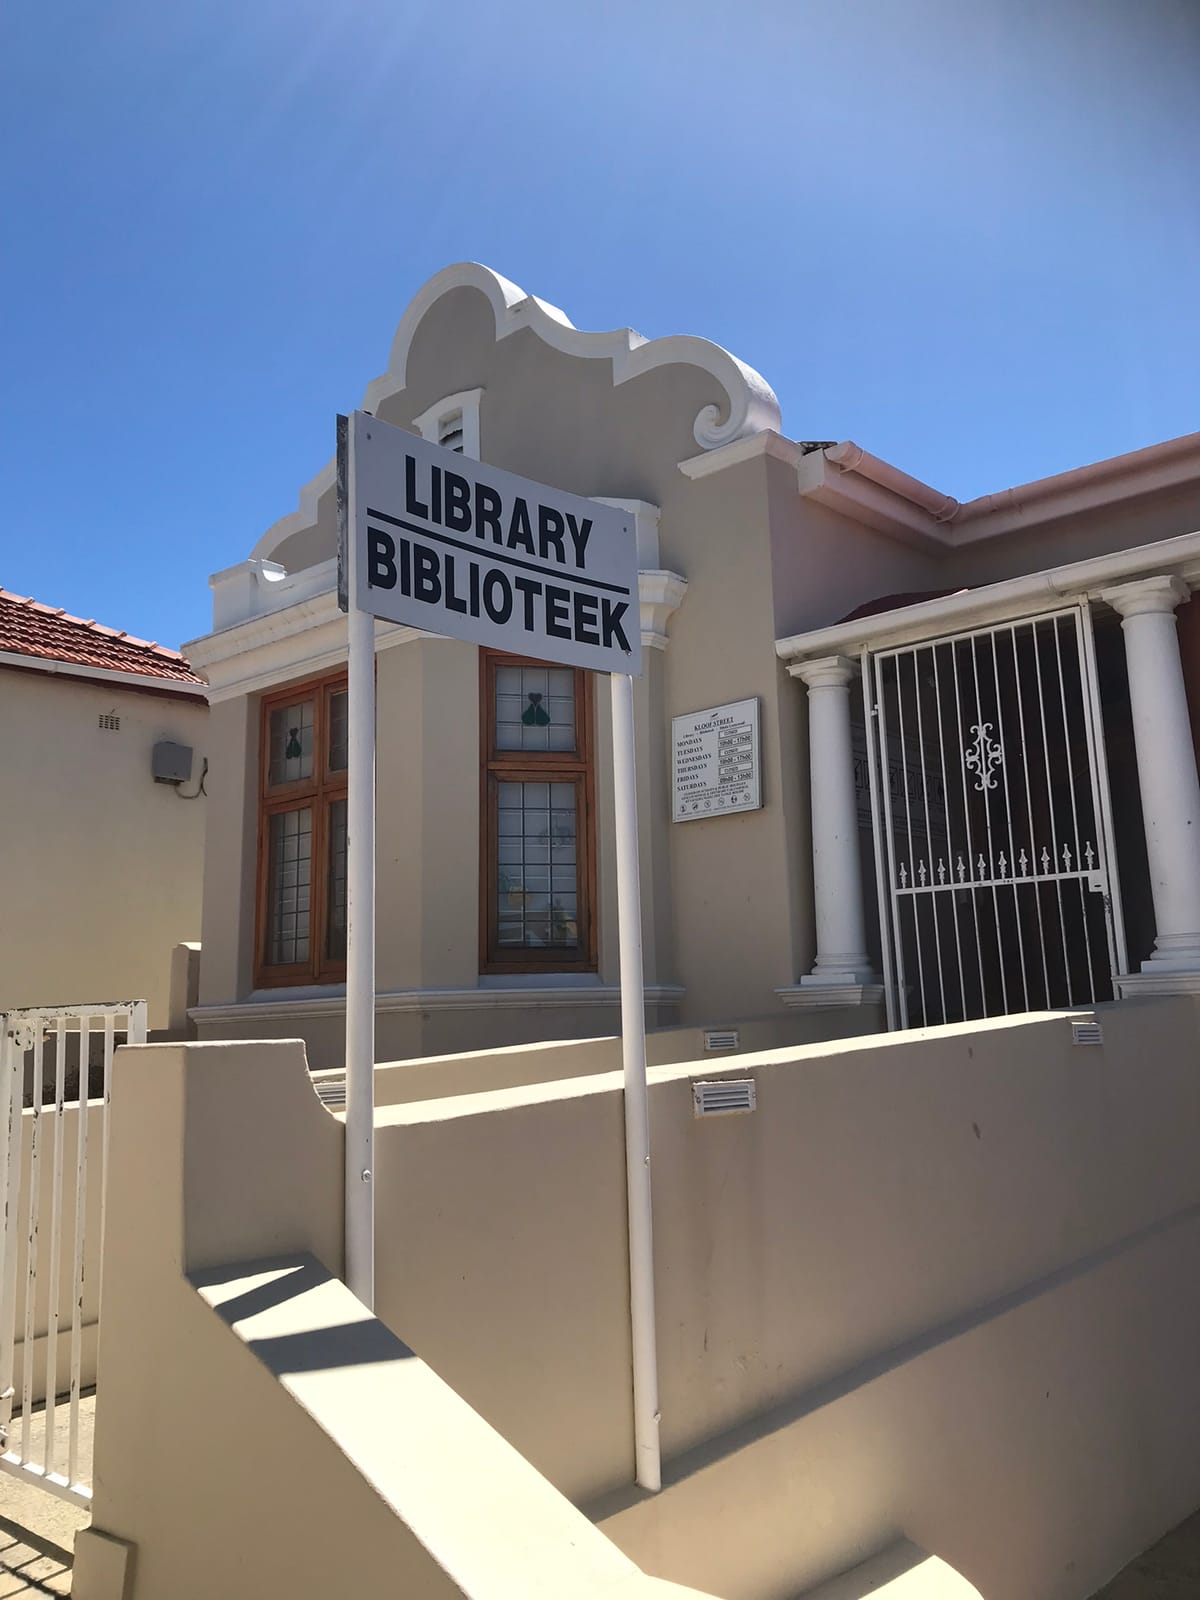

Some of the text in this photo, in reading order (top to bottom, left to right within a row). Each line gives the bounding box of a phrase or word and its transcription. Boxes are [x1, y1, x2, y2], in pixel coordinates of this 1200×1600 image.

[405, 454, 593, 569] LIBRARY
[367, 526, 632, 652] BIBLIOTEEK
[694, 722, 712, 731] KLOOF
[712, 717, 734, 728] STREET
[677, 737, 702, 747] MONDAYS
[677, 746, 703, 756] TUESDAYS
[677, 754, 712, 765] WEDNESDAYS
[677, 763, 707, 774] THURSDAYS
[677, 773, 699, 783] FRIDAYS
[677, 781, 707, 791] SATURDAYS
